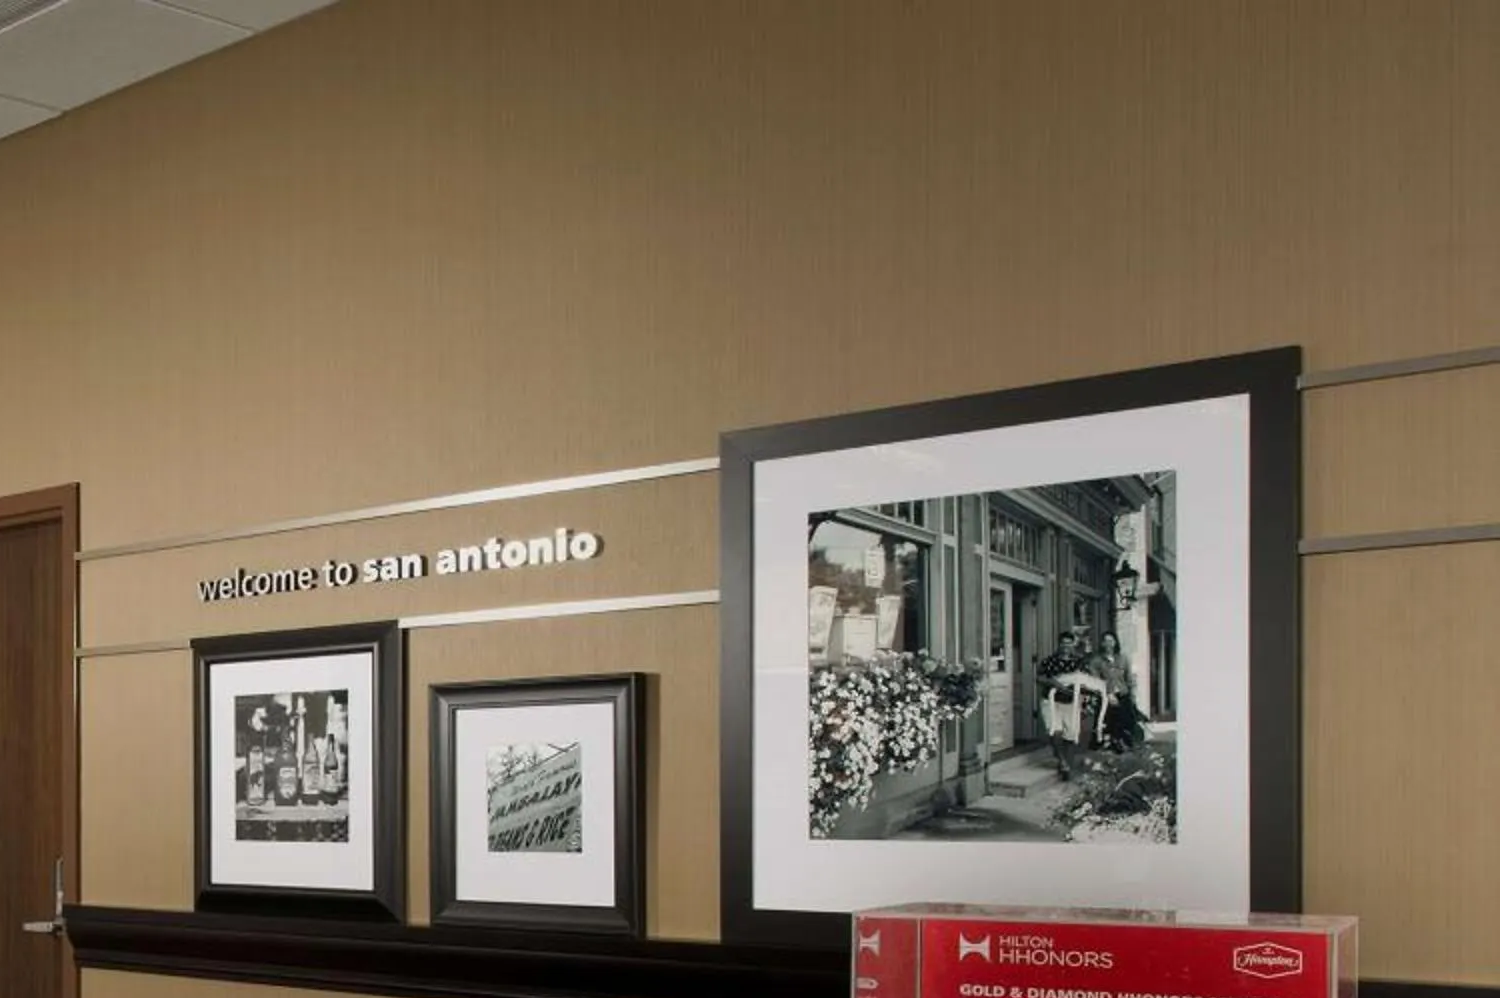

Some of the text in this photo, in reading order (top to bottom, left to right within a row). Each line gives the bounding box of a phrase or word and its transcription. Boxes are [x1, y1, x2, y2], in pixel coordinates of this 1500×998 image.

[197, 527, 604, 602] welcome to san antonio
[999, 935, 1054, 948] HILTON
[999, 949, 1114, 969] HHONORS
[959, 983, 1005, 997] GOLD
[1009, 986, 1023, 998] &
